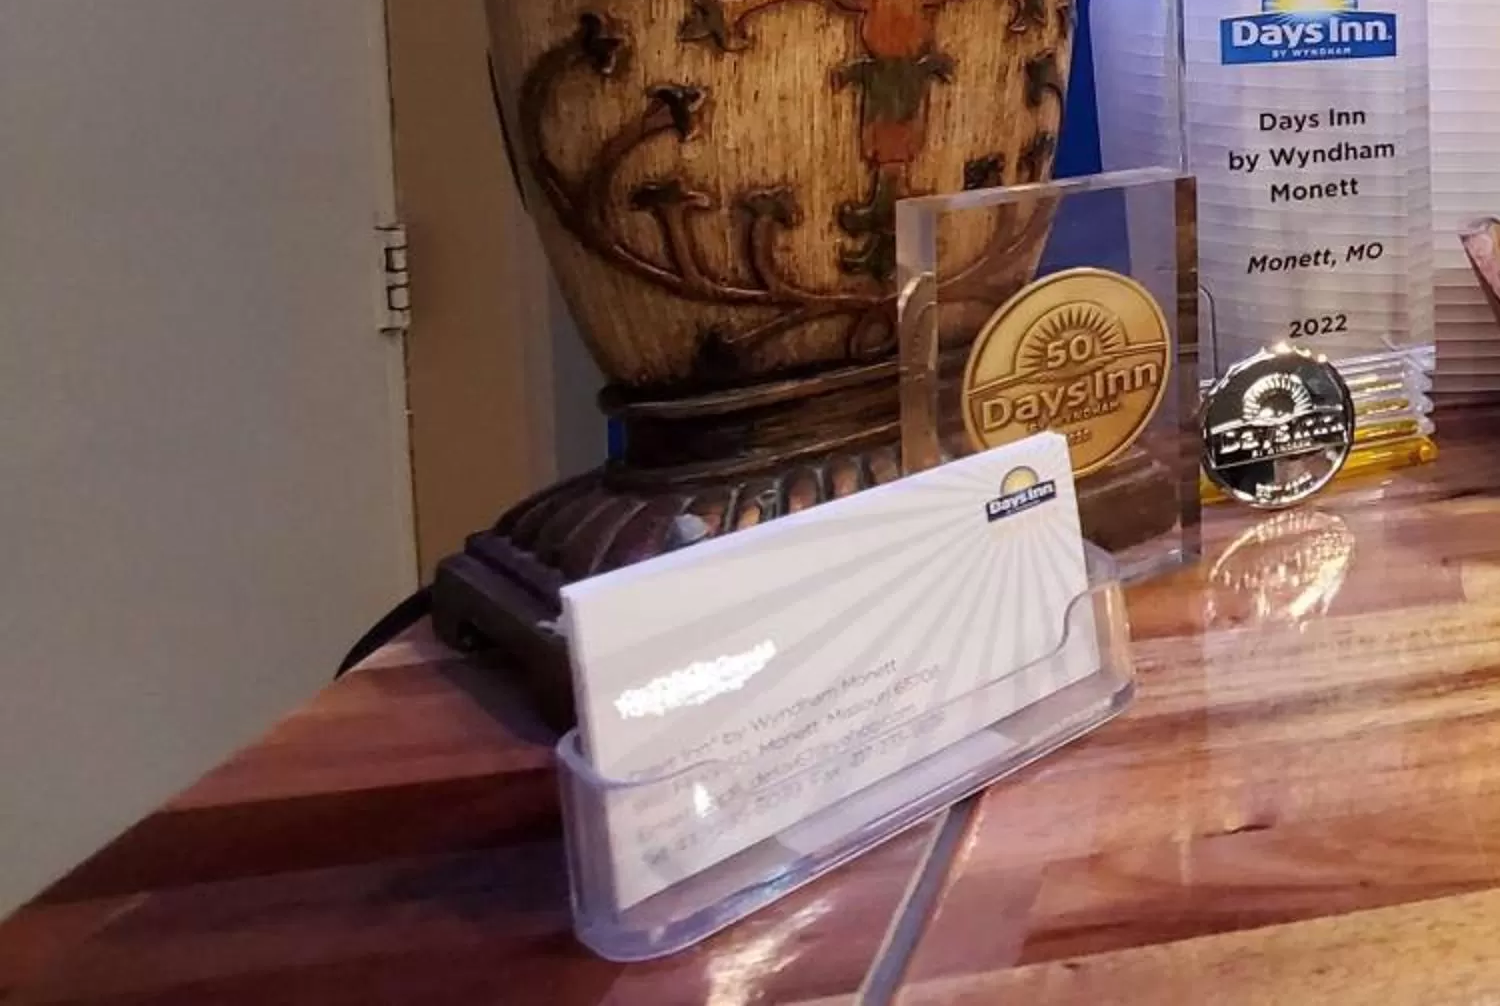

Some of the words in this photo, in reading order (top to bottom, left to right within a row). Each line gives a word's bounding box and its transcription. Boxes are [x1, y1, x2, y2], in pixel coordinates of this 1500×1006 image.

[1231, 19, 1324, 48] Days
[1271, 50, 1288, 59] BY
[1292, 47, 1352, 58] WYNDHAM
[1258, 112, 1320, 133] Days
[1328, 108, 1367, 127] Inn
[1228, 150, 1260, 173] by
[1268, 141, 1396, 169] Wyndham
[1270, 177, 1360, 203] Monett
[1246, 247, 1338, 275] Monett,
[1345, 241, 1385, 263] MO
[1288, 313, 1349, 339] 2022
[1046, 333, 1095, 370] 50
[981, 378, 1089, 432] Days
[1098, 360, 1159, 400] Inn
